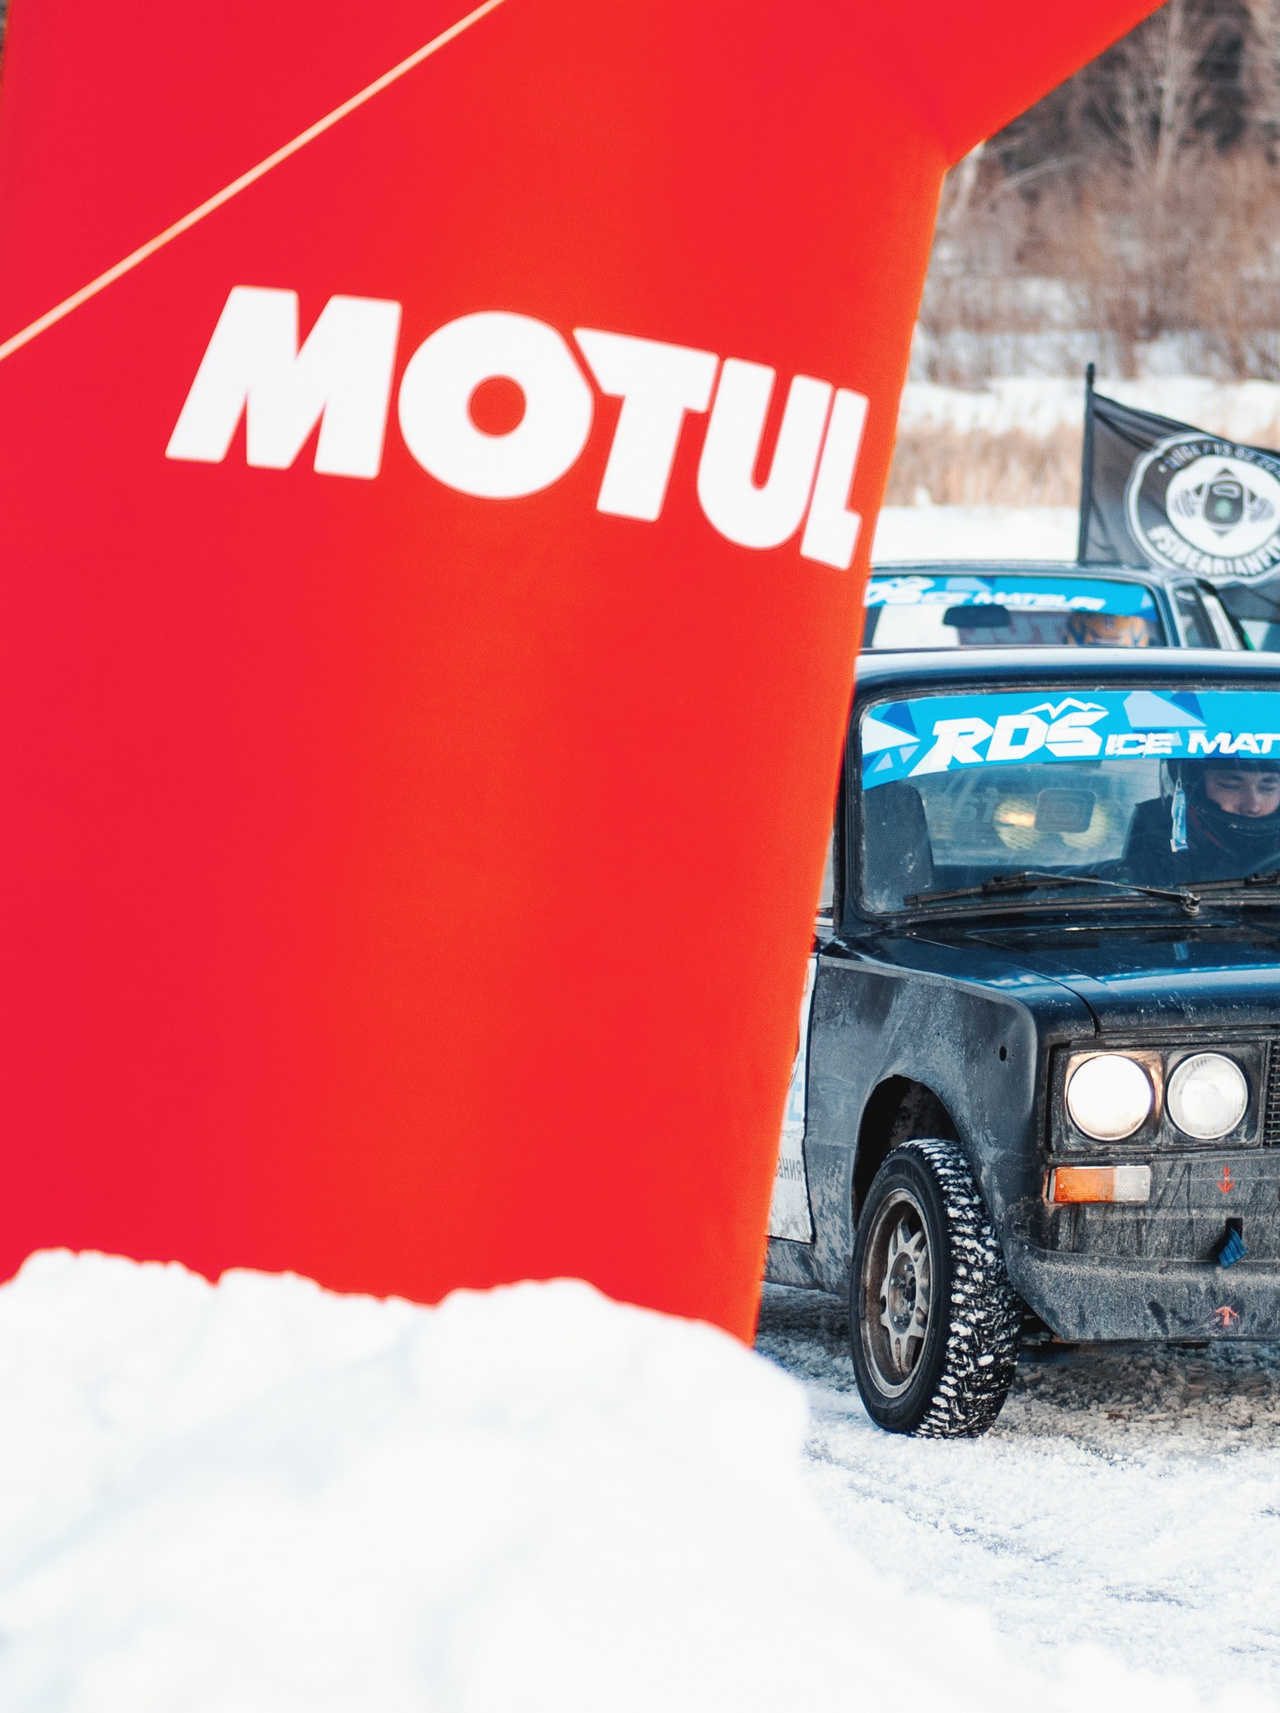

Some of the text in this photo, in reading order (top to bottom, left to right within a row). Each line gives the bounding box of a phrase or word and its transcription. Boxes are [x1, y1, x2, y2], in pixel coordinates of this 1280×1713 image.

[165, 285, 869, 570] MOTUL
[907, 710, 1109, 777] RDS
[1105, 733, 1174, 756] ICE
